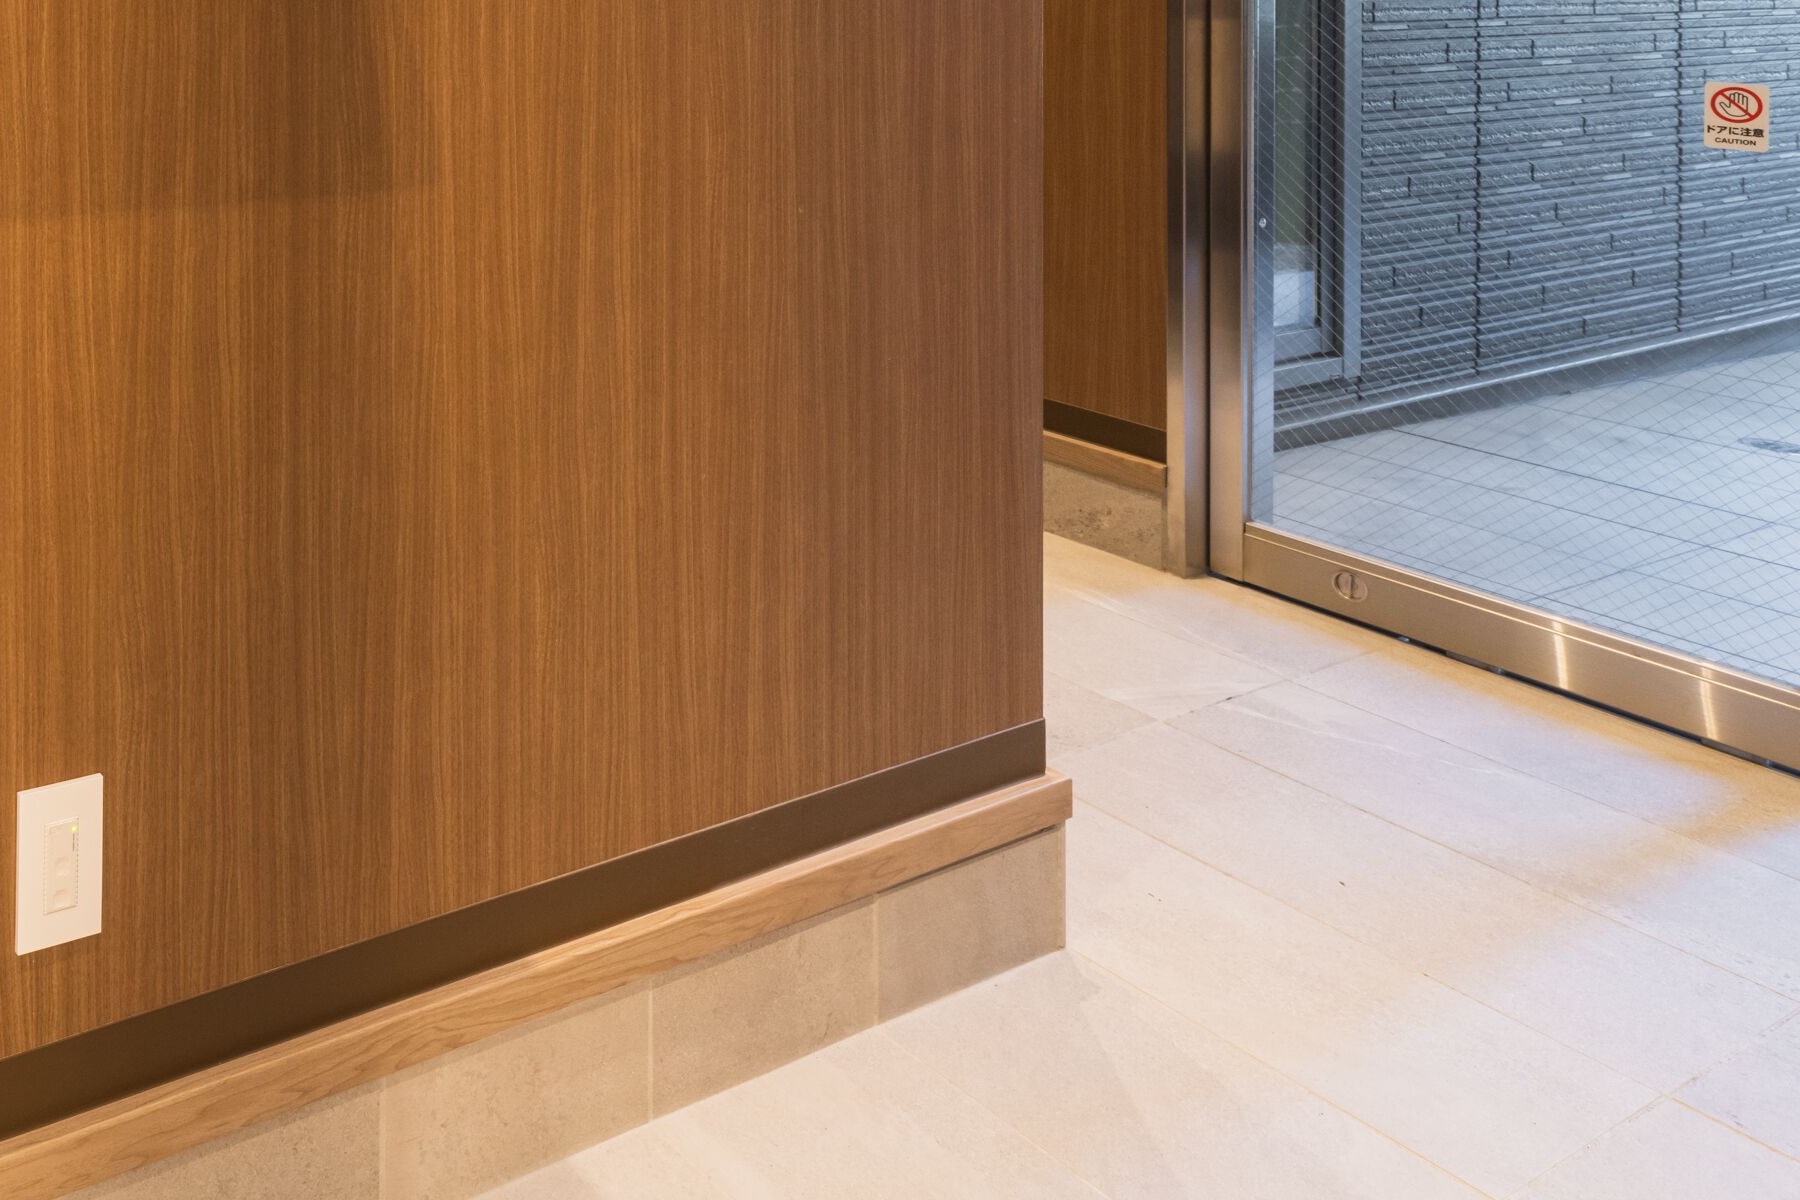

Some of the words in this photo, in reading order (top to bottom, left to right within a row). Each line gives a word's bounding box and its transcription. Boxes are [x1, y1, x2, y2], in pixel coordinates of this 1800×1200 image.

[1707, 125, 1765, 137] ドアに注意
[1715, 137, 1757, 146] CAUTION
